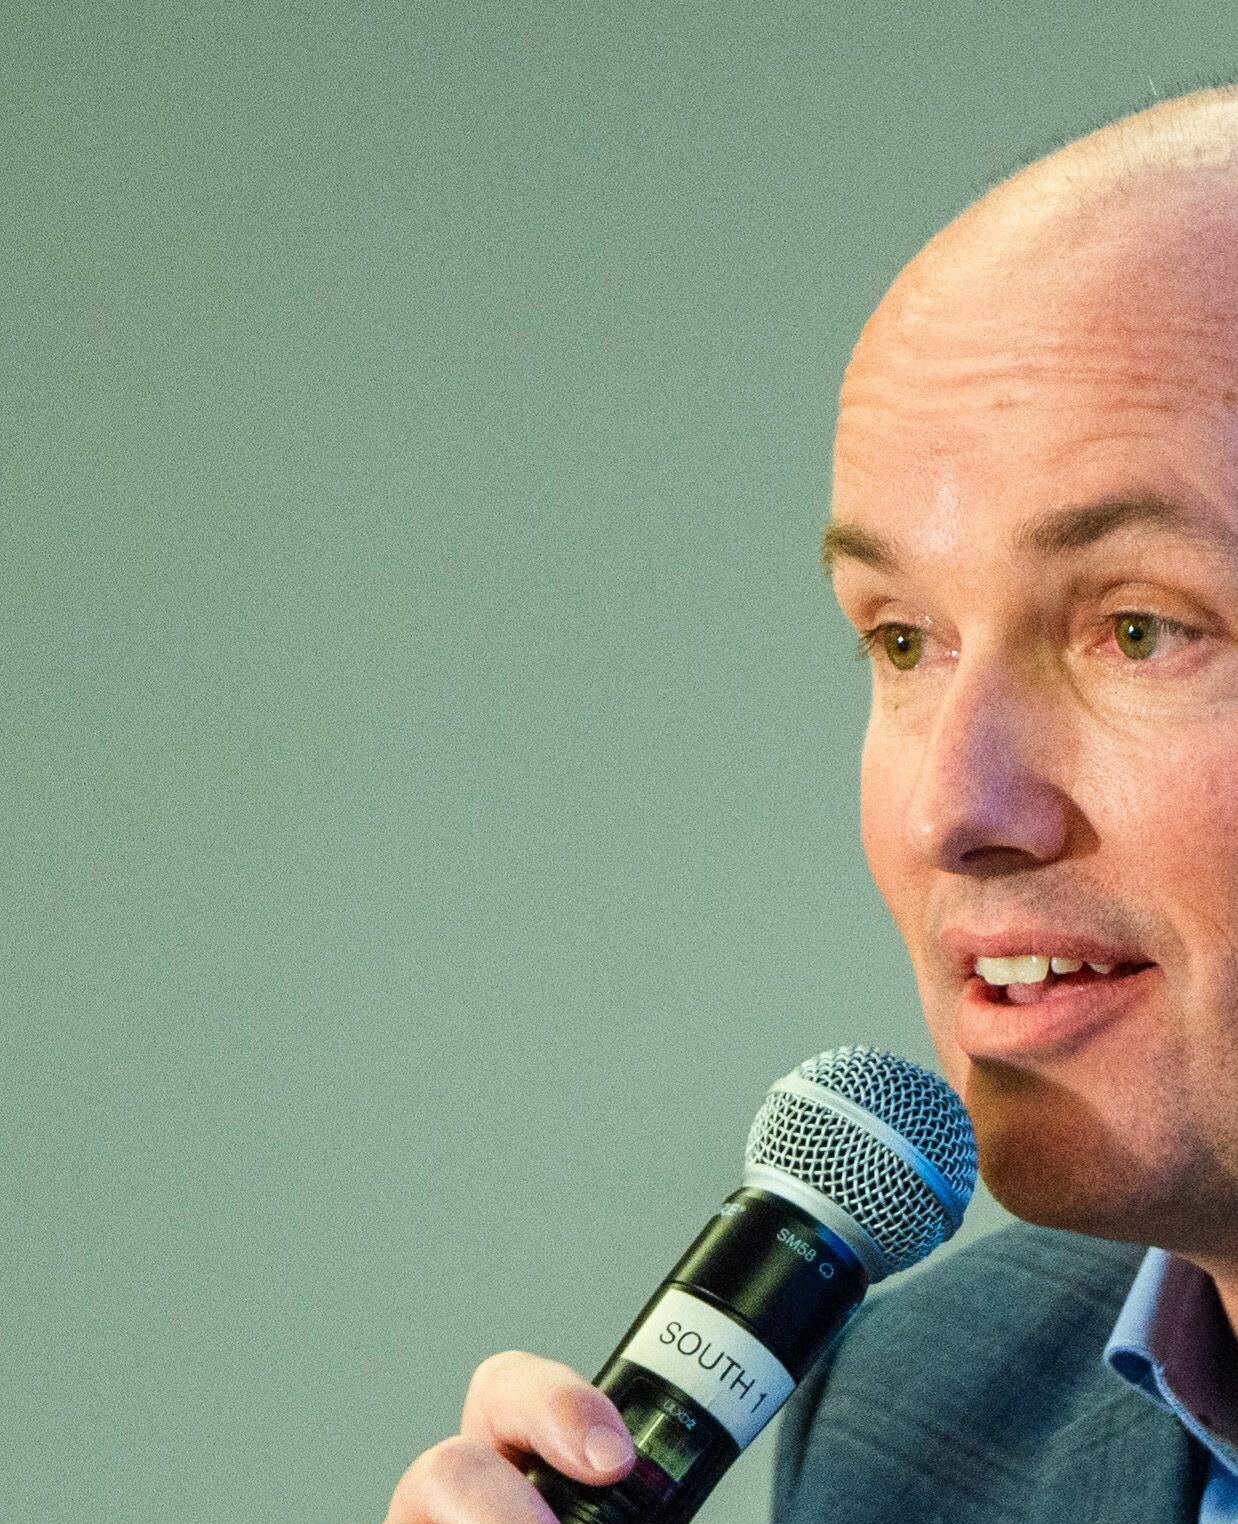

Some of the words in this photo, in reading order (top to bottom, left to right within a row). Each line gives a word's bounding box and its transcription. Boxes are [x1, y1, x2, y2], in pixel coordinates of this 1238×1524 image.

[776, 1228, 817, 1262] SM58
[659, 1321, 757, 1400] SOUTH
[750, 1392, 768, 1413] 1
